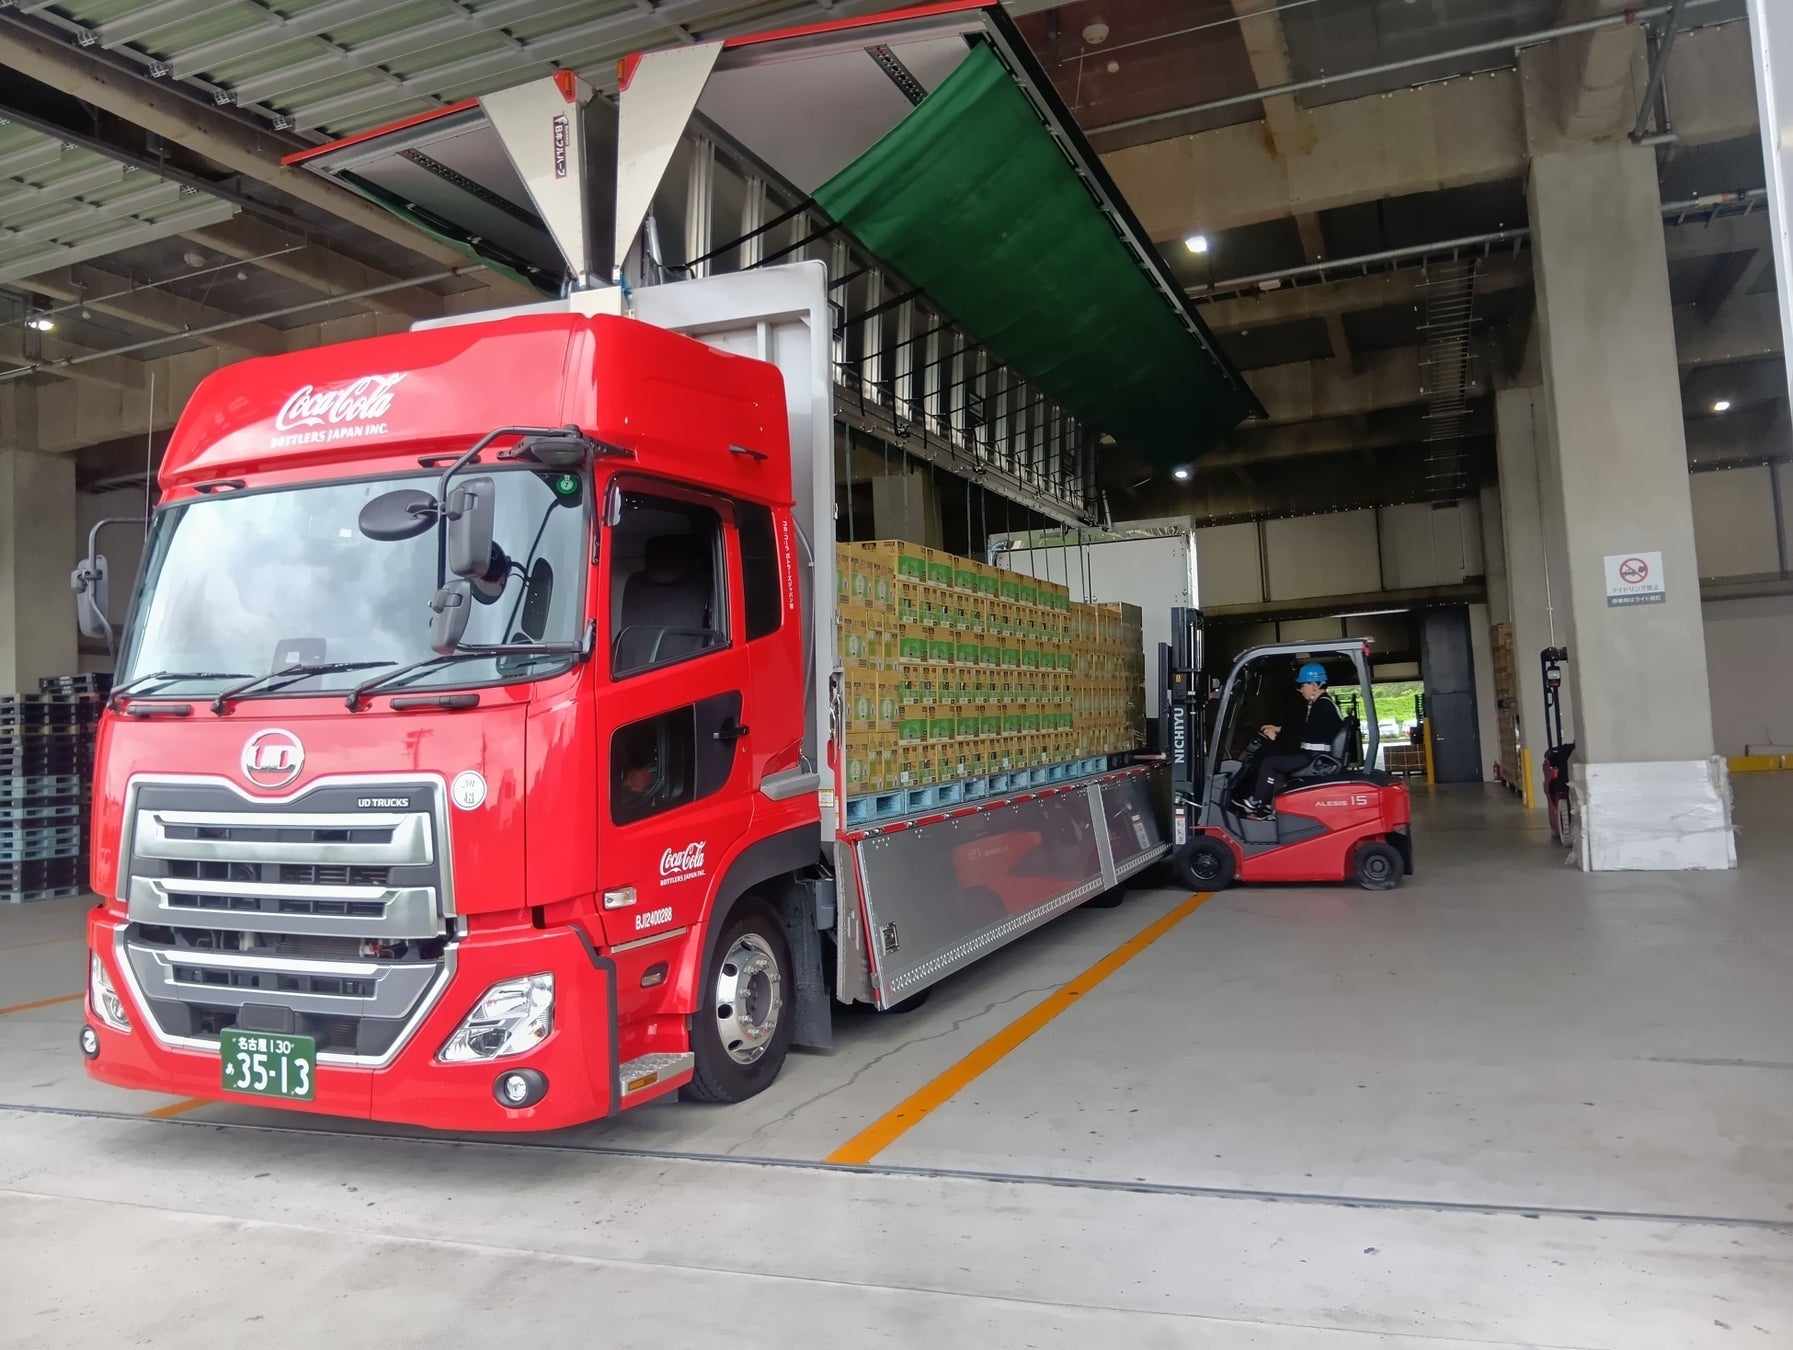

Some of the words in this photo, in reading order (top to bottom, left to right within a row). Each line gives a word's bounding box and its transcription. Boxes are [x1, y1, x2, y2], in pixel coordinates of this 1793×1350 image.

[555, 125, 565, 176] 日本フルハーフ
[275, 370, 409, 432] Coca-Cola
[269, 430, 327, 449] BOTTLERS
[327, 425, 363, 442] JAPAN
[364, 422, 389, 436] INC.
[1174, 707, 1185, 764] NICHIYU
[358, 798, 371, 808] UD
[372, 798, 409, 808] TRUCKS
[1350, 795, 1368, 806] 15
[660, 839, 707, 876] Coca-Cola
[660, 875, 684, 887] BOTTLERS
[683, 871, 698, 882] JAPAN
[697, 869, 707, 878] INC.
[238, 1036, 267, 1052] 名古屋
[270, 1039, 291, 1054] 130
[225, 1062, 235, 1076] あ
[236, 1052, 310, 1096] 35-13
